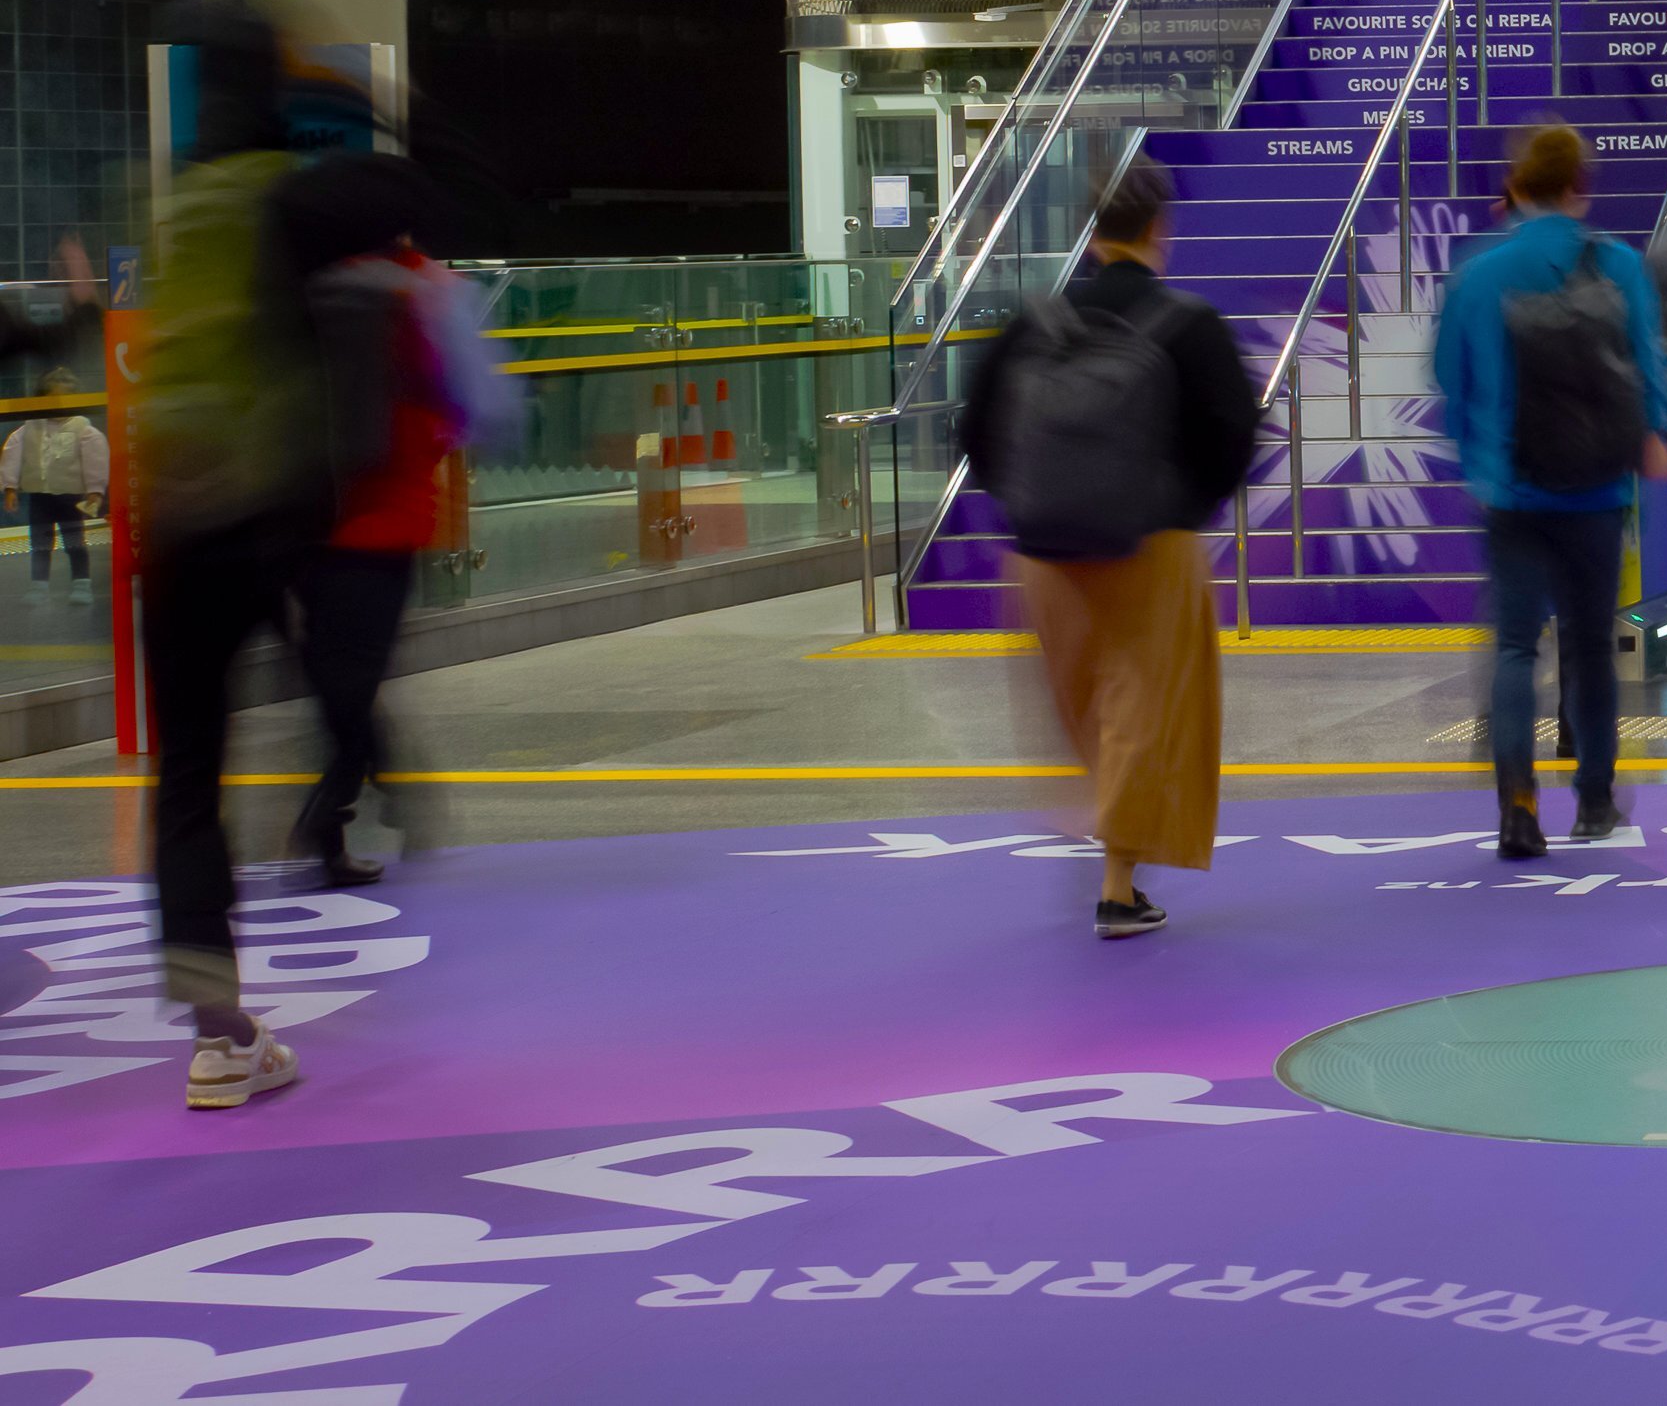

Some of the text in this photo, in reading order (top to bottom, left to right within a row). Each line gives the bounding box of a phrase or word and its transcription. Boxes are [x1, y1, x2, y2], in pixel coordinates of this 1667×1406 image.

[1313, 15, 1407, 31] FAVOURITE
[1502, 13, 1553, 28] REPEA
[1309, 47, 1357, 62] DROP
[1362, 46, 1375, 60] A
[1379, 45, 1409, 60] PIN
[1608, 42, 1656, 56] DROP
[1267, 140, 1354, 156] STREAMS
